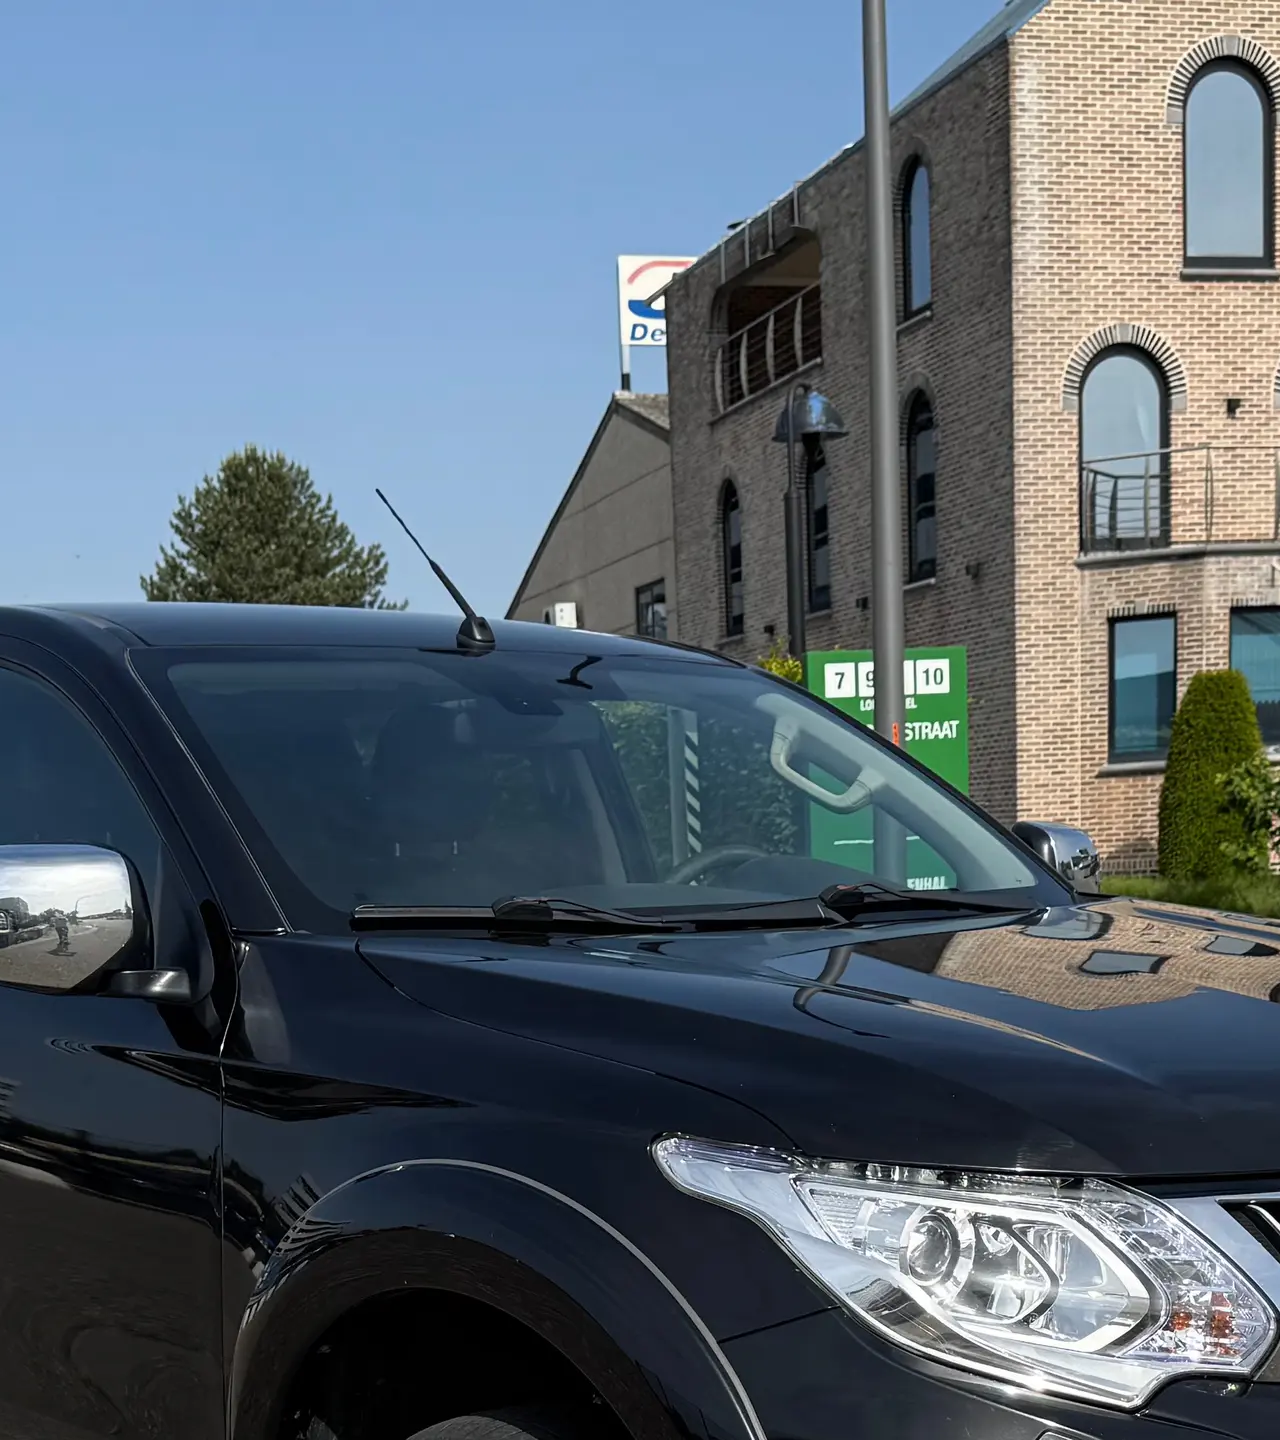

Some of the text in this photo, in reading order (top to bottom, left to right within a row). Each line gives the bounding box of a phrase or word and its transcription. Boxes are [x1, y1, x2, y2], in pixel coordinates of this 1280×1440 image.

[629, 323, 667, 342] De
[834, 672, 845, 690] 7
[922, 667, 943, 687] 10
